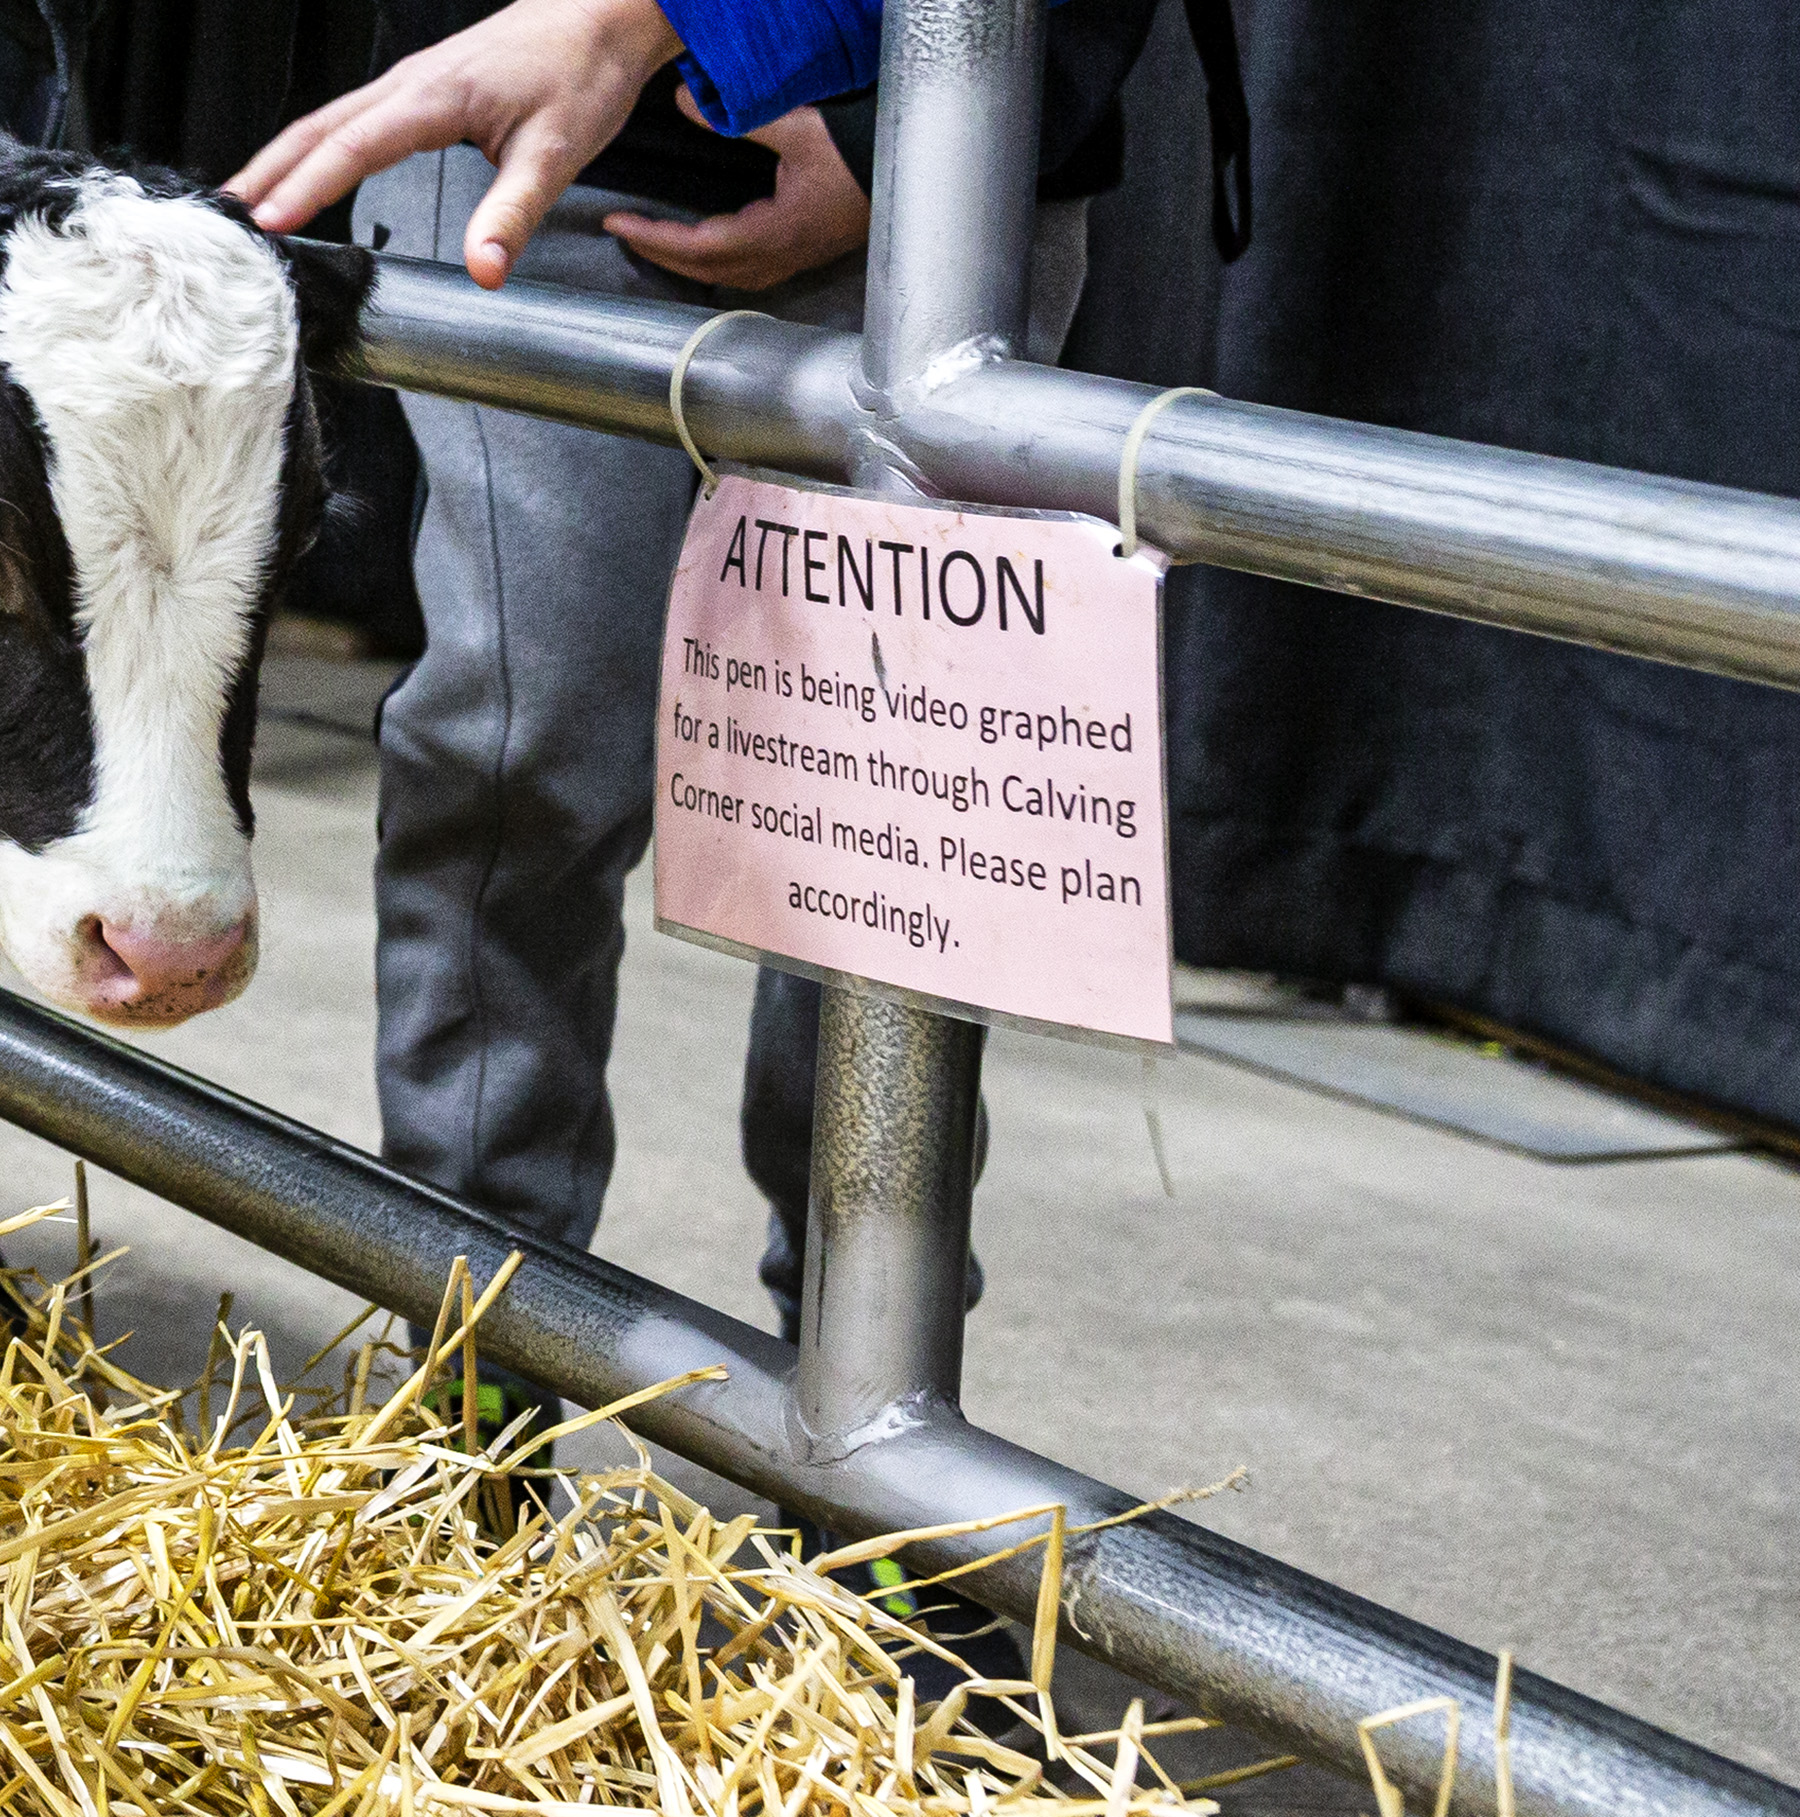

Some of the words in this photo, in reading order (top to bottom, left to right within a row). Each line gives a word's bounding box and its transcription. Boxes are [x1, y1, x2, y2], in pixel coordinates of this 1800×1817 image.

[719, 515, 1046, 636] ATTENTION
[683, 636, 720, 679] This
[726, 651, 767, 698] pen
[775, 660, 792, 697] is
[801, 663, 877, 721] being
[884, 682, 969, 730] video
[979, 702, 1133, 754] graphed
[673, 703, 702, 743] for
[708, 718, 719, 748] a
[726, 714, 858, 782] livestream
[867, 750, 990, 813] through
[1002, 774, 1137, 839] Calving
[670, 773, 745, 825] Corner
[751, 800, 822, 845] social
[831, 824, 929, 870] media.
[940, 836, 1047, 892] Please
[1060, 858, 1143, 907] plan
[788, 878, 960, 954] accordingly.
